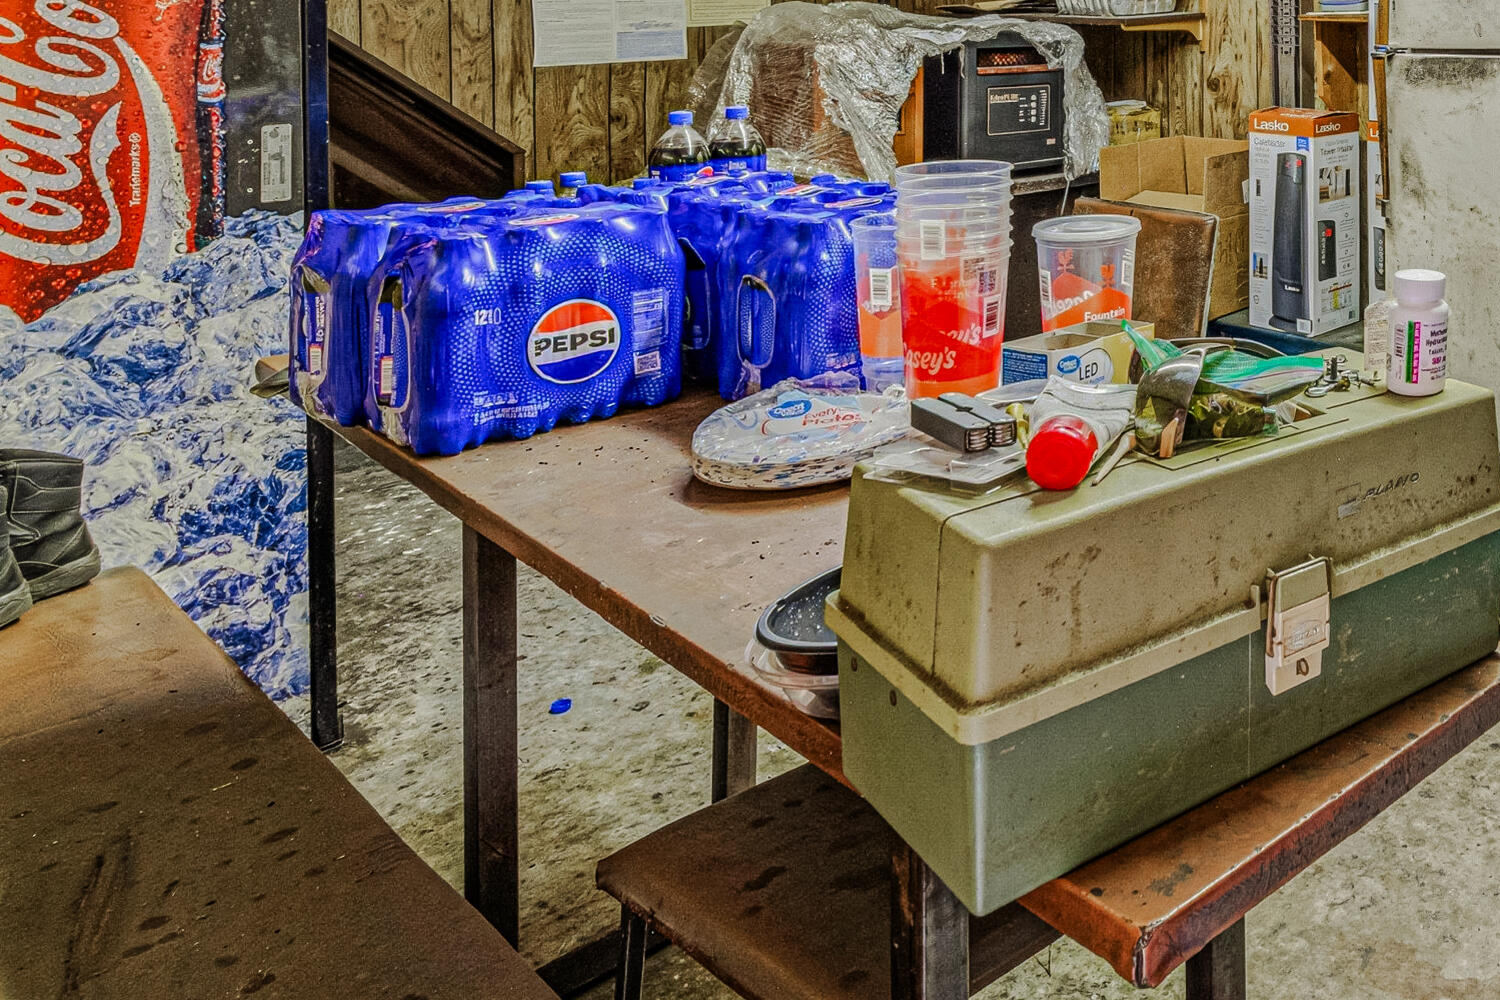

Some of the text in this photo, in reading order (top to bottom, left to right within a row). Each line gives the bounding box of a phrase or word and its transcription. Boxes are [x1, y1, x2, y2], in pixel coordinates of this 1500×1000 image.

[1253, 117, 1289, 132] Lasko
[1315, 122, 1341, 134] Lasko
[1084, 306, 1126, 323] Fountain
[534, 327, 615, 357] PEPSI
[1078, 361, 1098, 381] LED
[1362, 472, 1420, 503] PLANO
